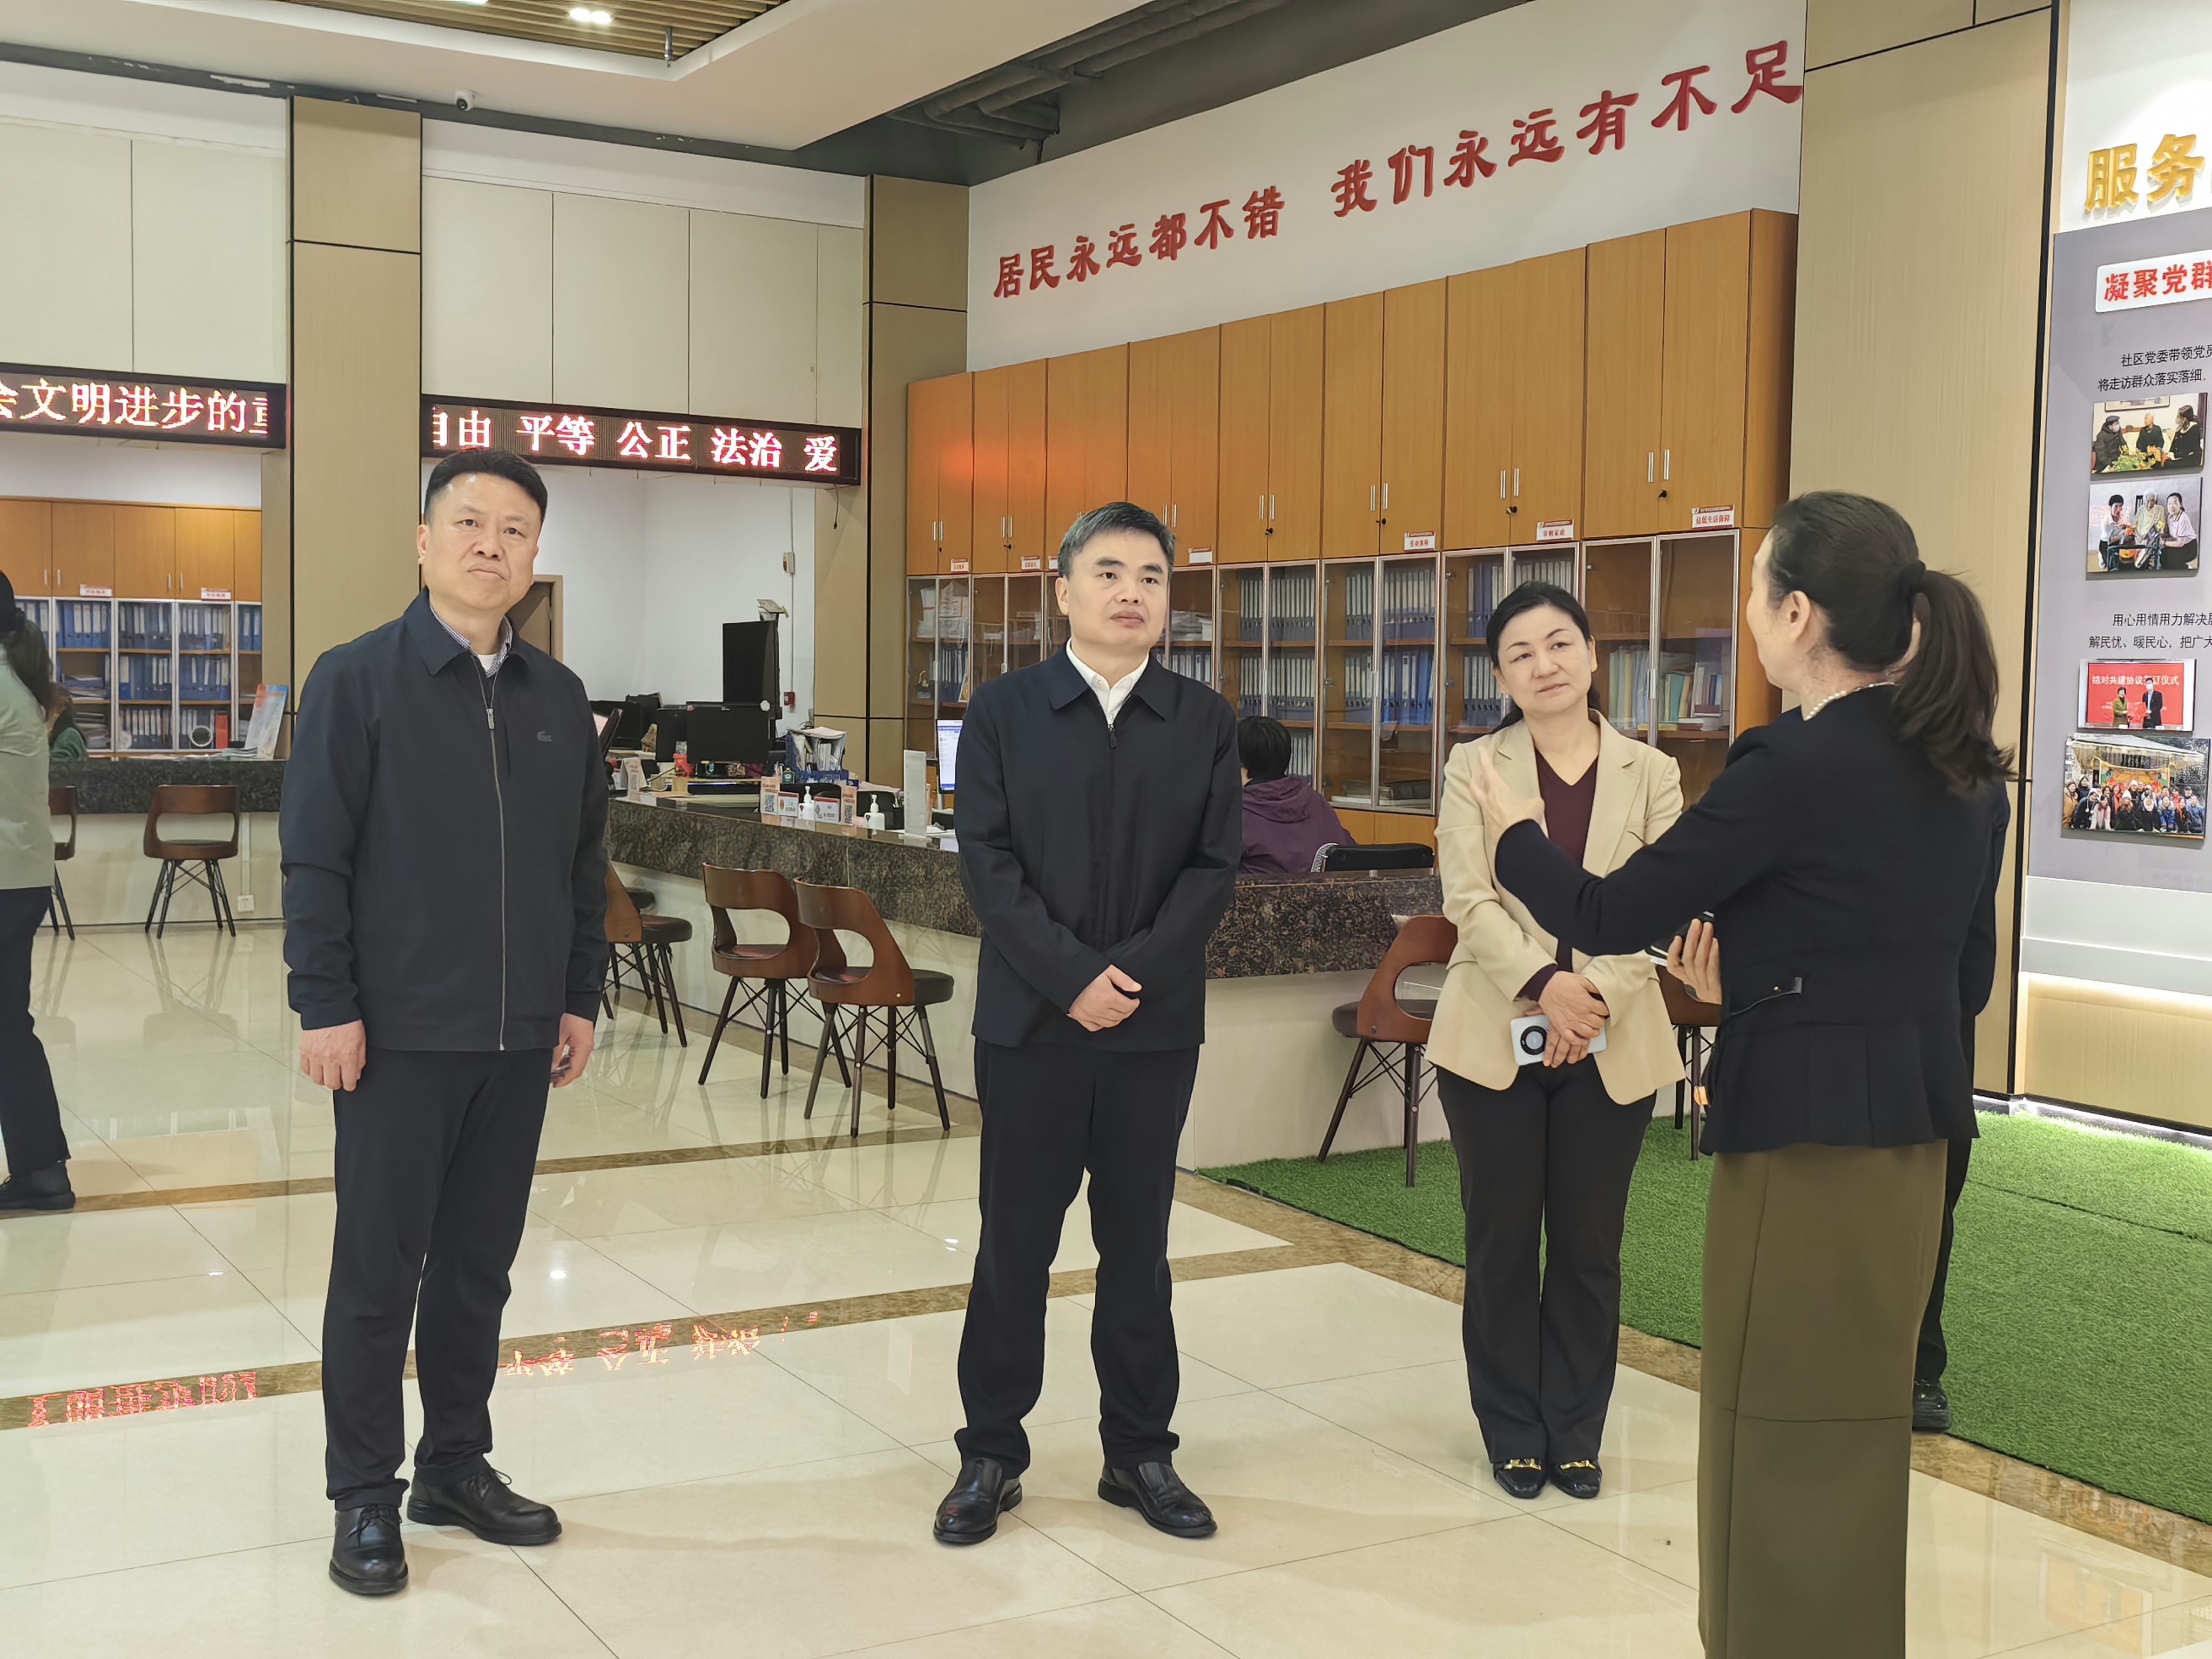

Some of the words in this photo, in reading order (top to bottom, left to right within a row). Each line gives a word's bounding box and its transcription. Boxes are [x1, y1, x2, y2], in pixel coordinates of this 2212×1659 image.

[994, 186, 1285, 298] 居民永远都不错
[1331, 39, 1803, 218] 我们永远有不足
[516, 415, 595, 456] 平等
[616, 421, 692, 461] 公正
[711, 428, 783, 468] 法治
[804, 434, 838, 473] 爱
